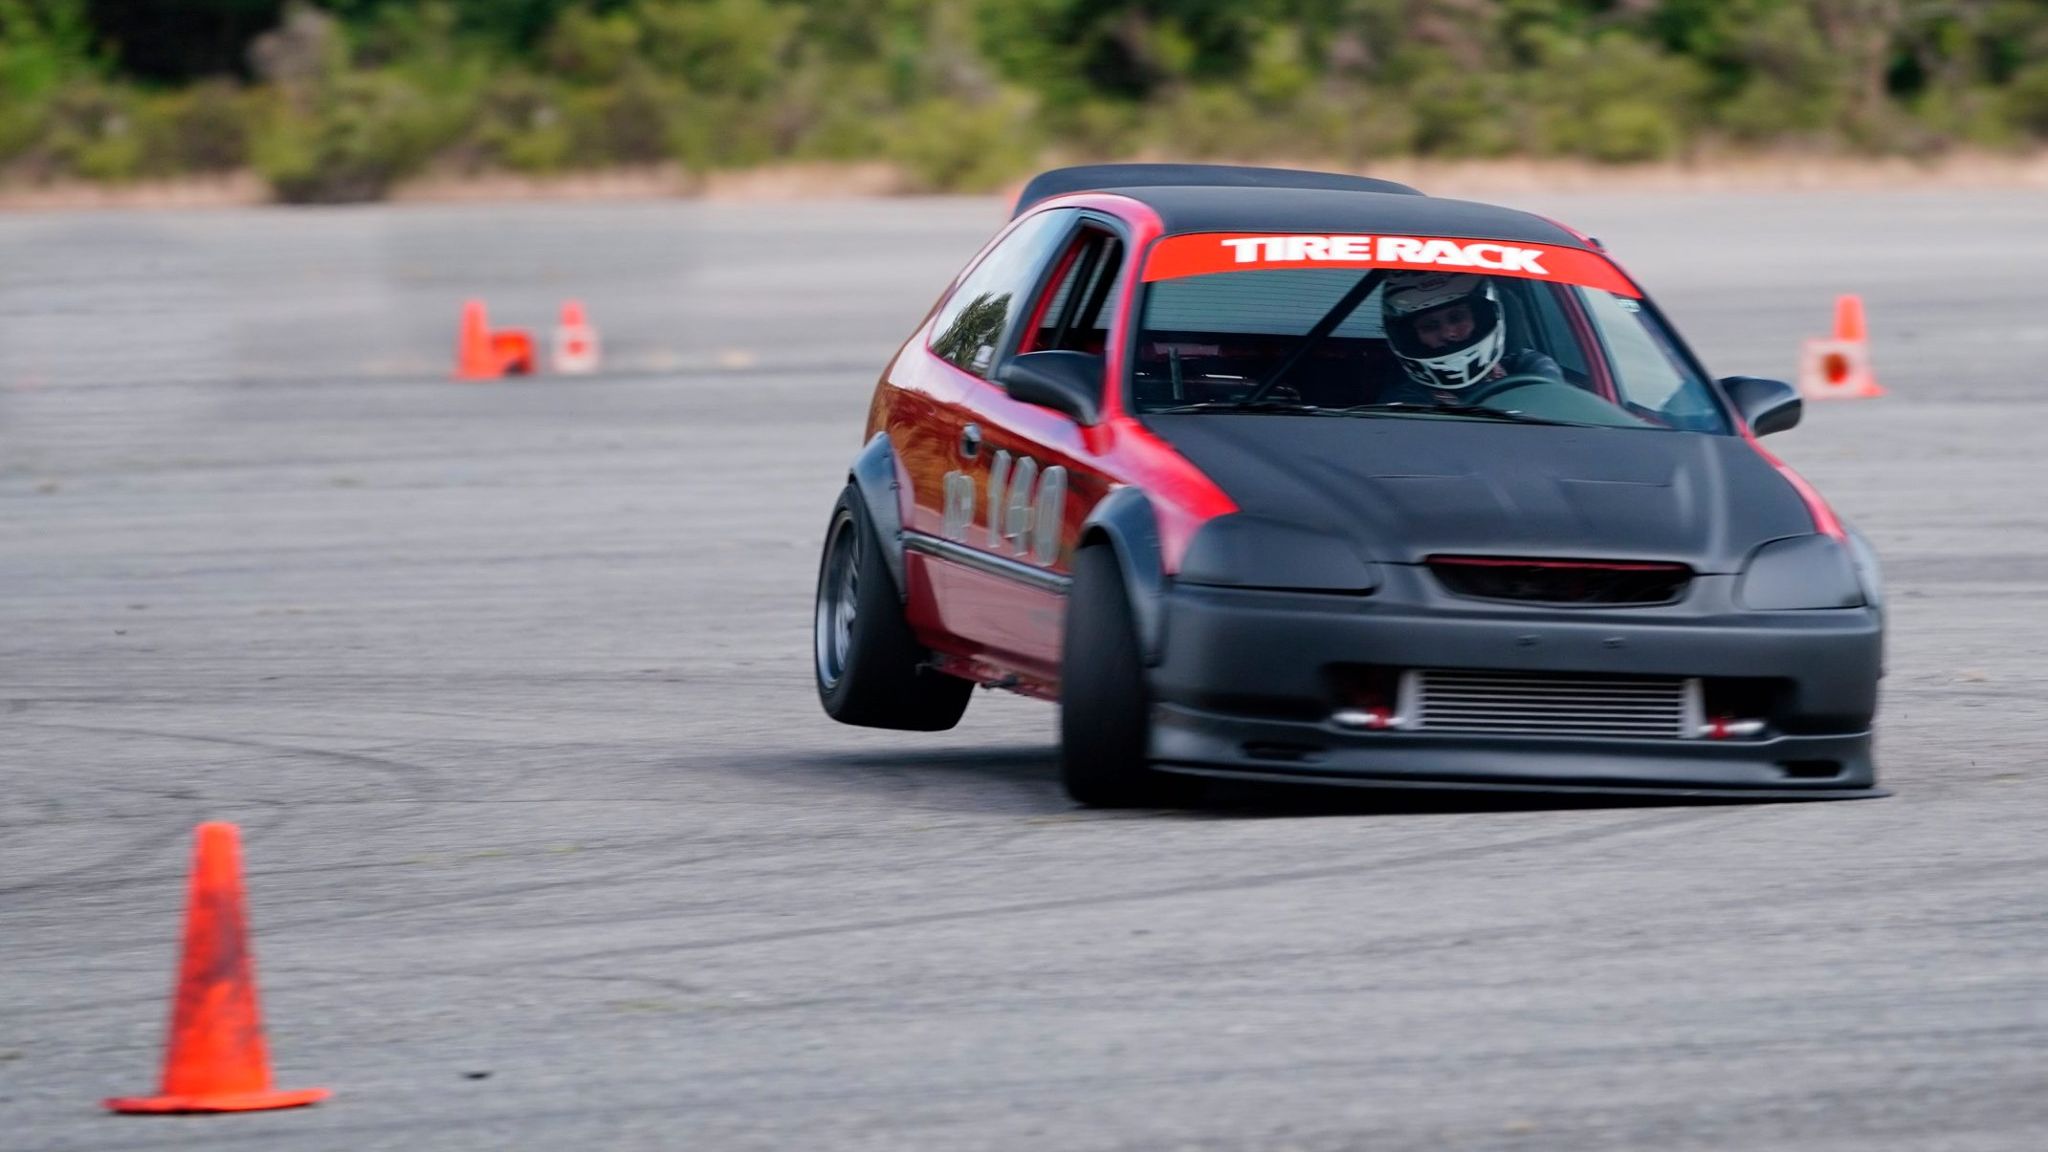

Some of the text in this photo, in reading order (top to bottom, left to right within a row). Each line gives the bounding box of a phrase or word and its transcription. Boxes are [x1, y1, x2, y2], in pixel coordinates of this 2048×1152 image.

[1221, 236, 1549, 275] TIRE RACK
[988, 449, 1068, 567] 140
